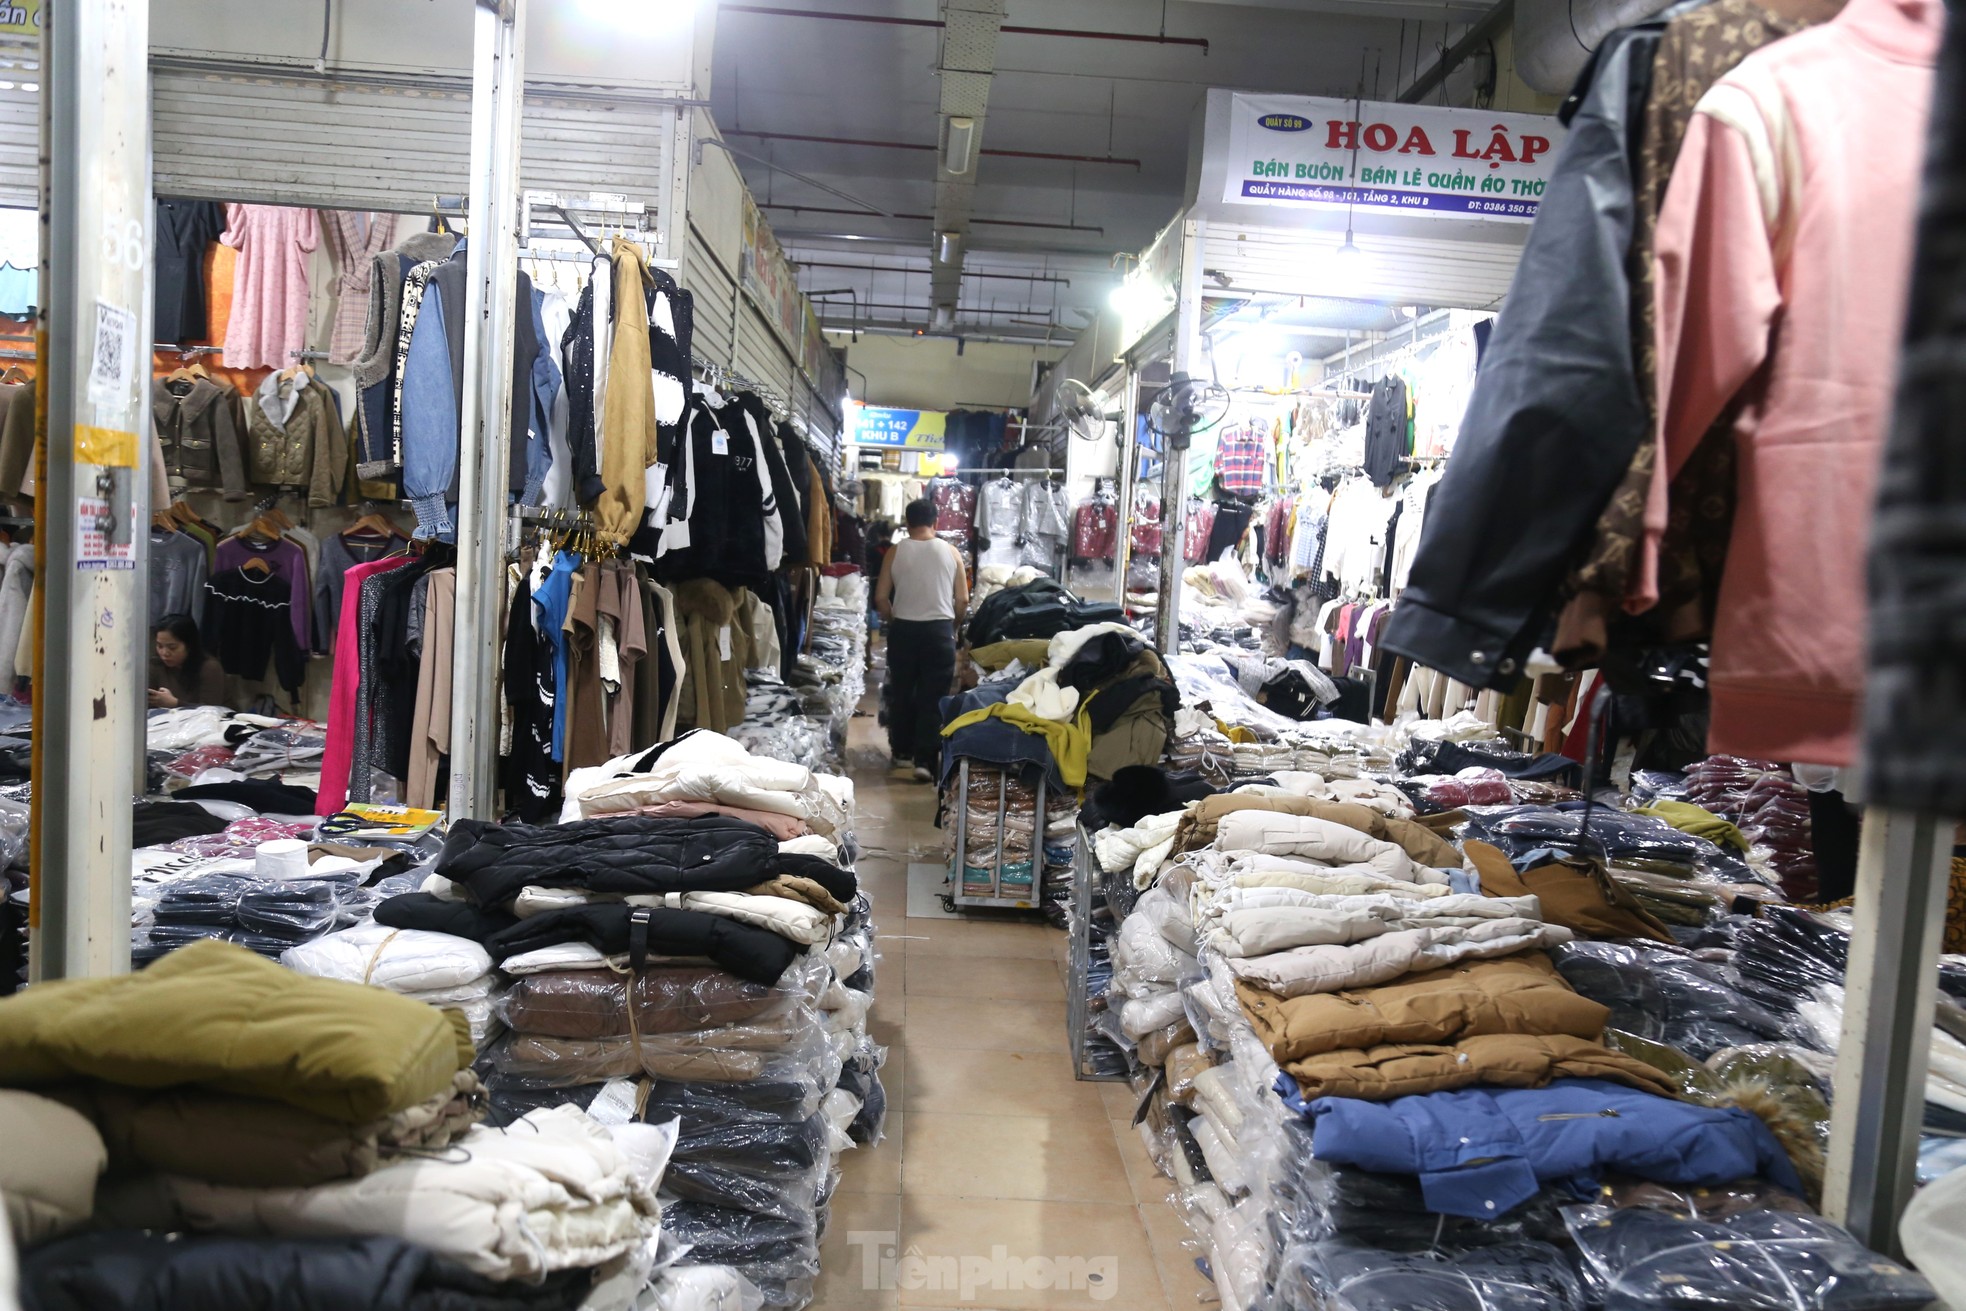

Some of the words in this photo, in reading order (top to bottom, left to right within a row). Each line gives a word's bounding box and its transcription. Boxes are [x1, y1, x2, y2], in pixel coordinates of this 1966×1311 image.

[1325, 120, 1436, 155] HOA
[1452, 124, 1550, 169] LẬP
[1253, 159, 1289, 178] BÁN
[1295, 162, 1344, 181] BUÔN
[1361, 165, 1397, 185] BÁN
[1403, 168, 1422, 186] LẺ
[1428, 168, 1476, 191] QUẦN
[1481, 174, 1505, 192] ÁO
[1511, 178, 1547, 196] THỜ
[1278, 185, 1306, 197] HÀNG
[1307, 187, 1322, 198] SỐ
[1323, 190, 1334, 199] 98
[1390, 195, 1399, 205] 2,
[1401, 195, 1421, 205] KHU
[1423, 197, 1429, 205] B
[1468, 201, 1482, 210] ĐT:
[1484, 202, 1505, 212] 0386
[1507, 204, 1524, 213] 350
[1526, 206, 1540, 214] 52
[862, 430, 887, 441] KHU
[891, 431, 899, 441] B
[888, 420, 907, 431] 142
